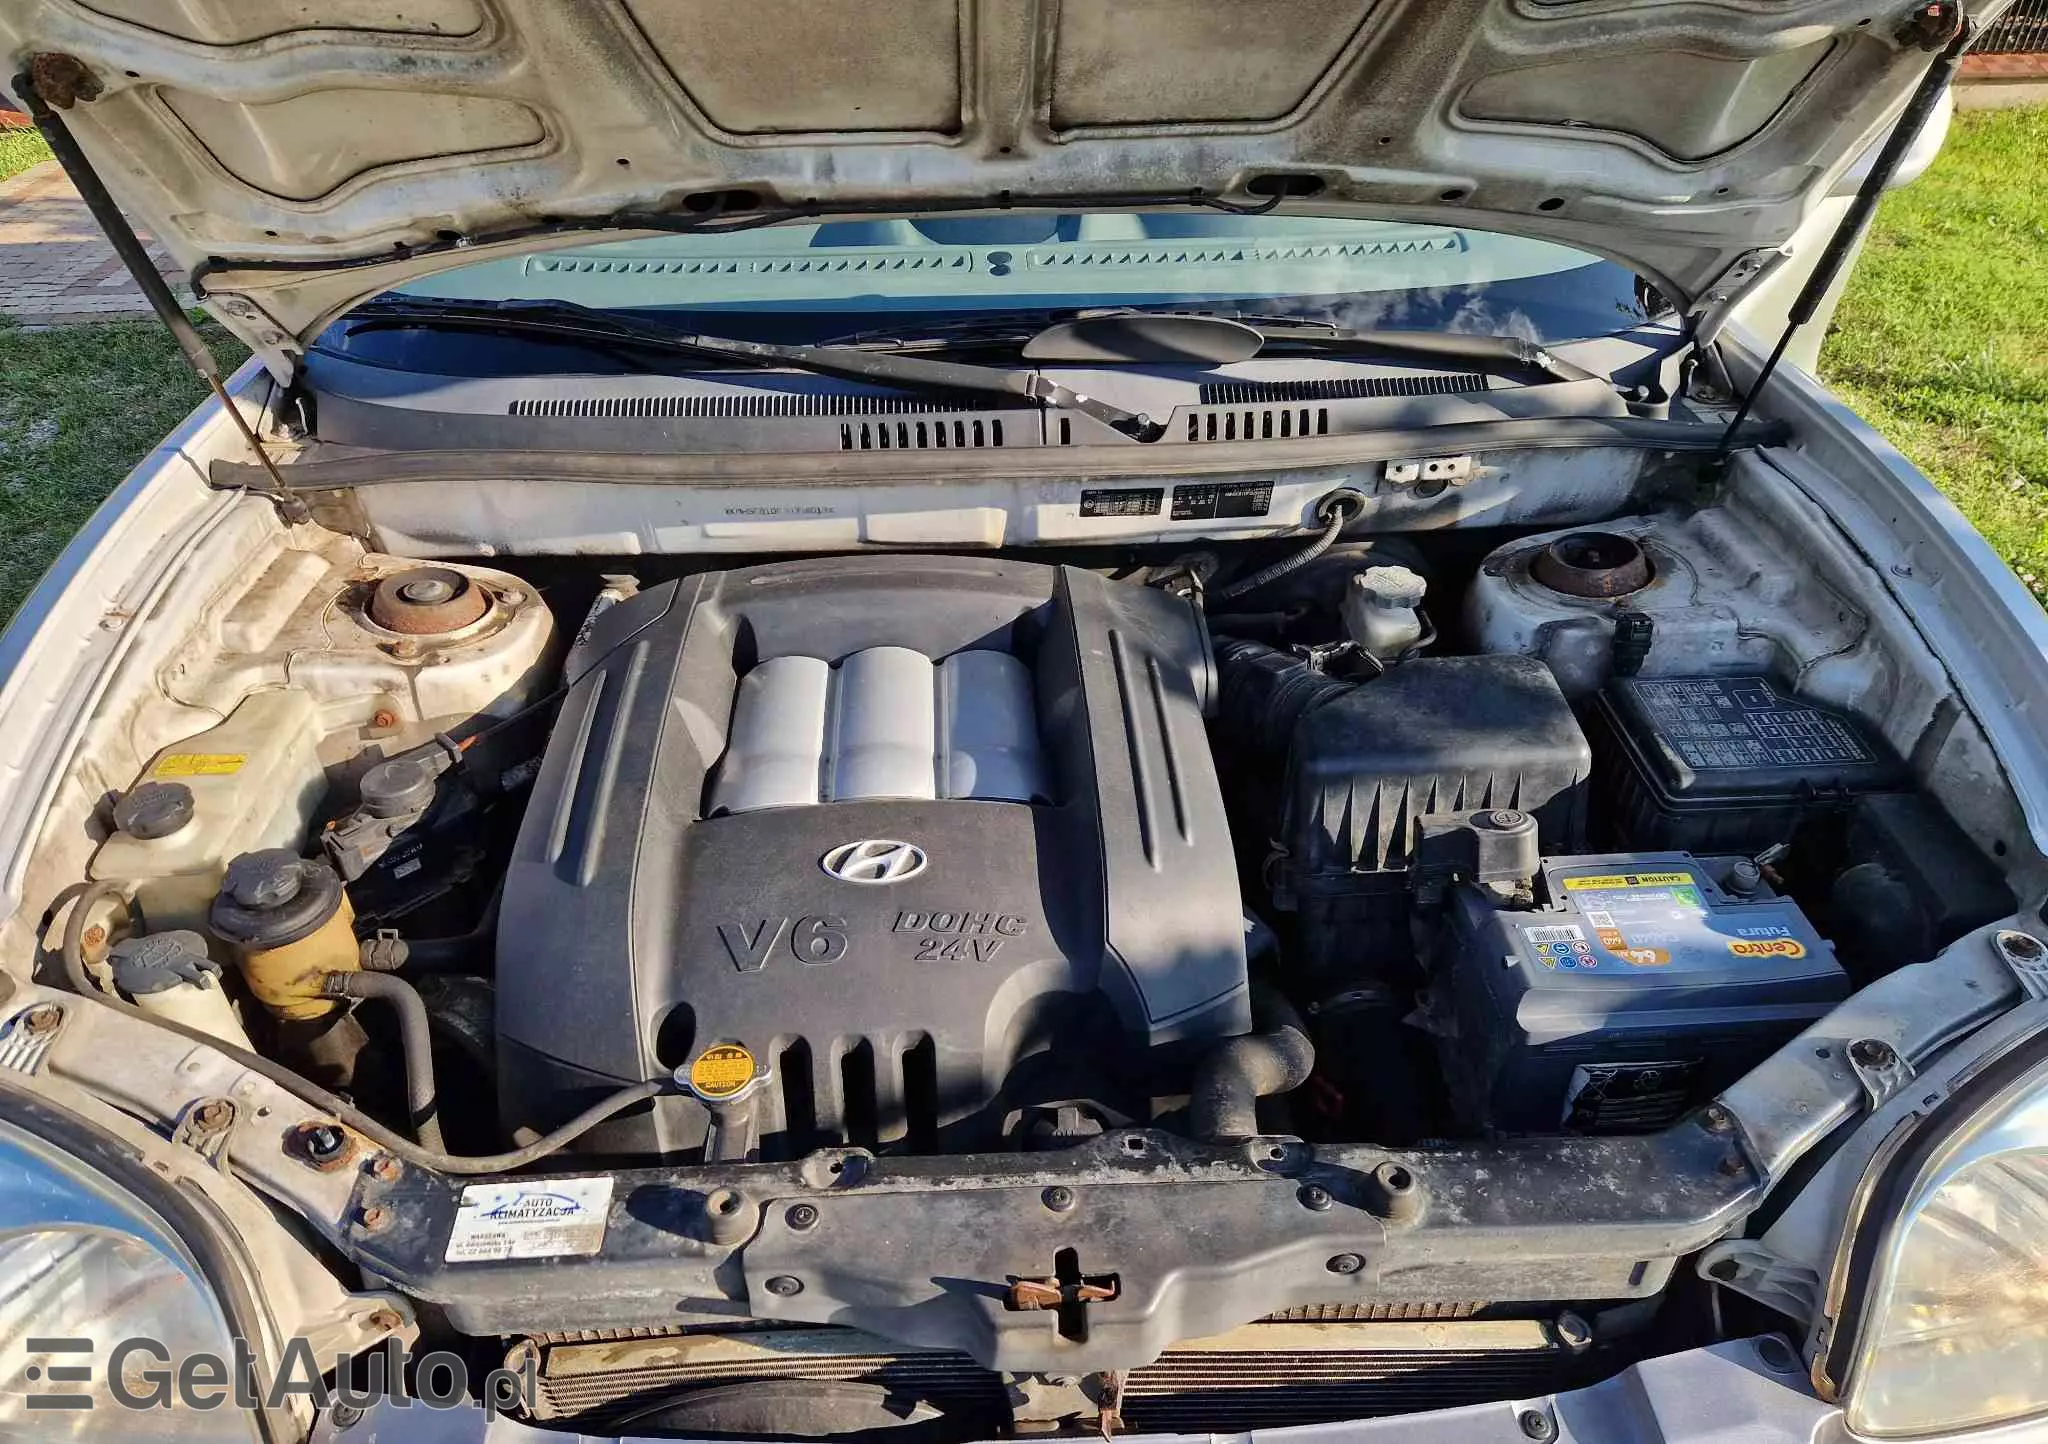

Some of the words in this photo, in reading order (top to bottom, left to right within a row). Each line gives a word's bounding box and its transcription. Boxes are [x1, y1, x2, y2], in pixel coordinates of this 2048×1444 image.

[1641, 875, 1681, 884] CAUTION
[892, 911, 1029, 937] DOHC
[1736, 926, 1792, 937] Futura
[716, 914, 849, 974] V6
[914, 937, 1004, 963] 24V
[1731, 940, 1801, 957] Centra
[524, 1198, 553, 1208] AUTO
[489, 1207, 575, 1221] KLIMATYZACJA
